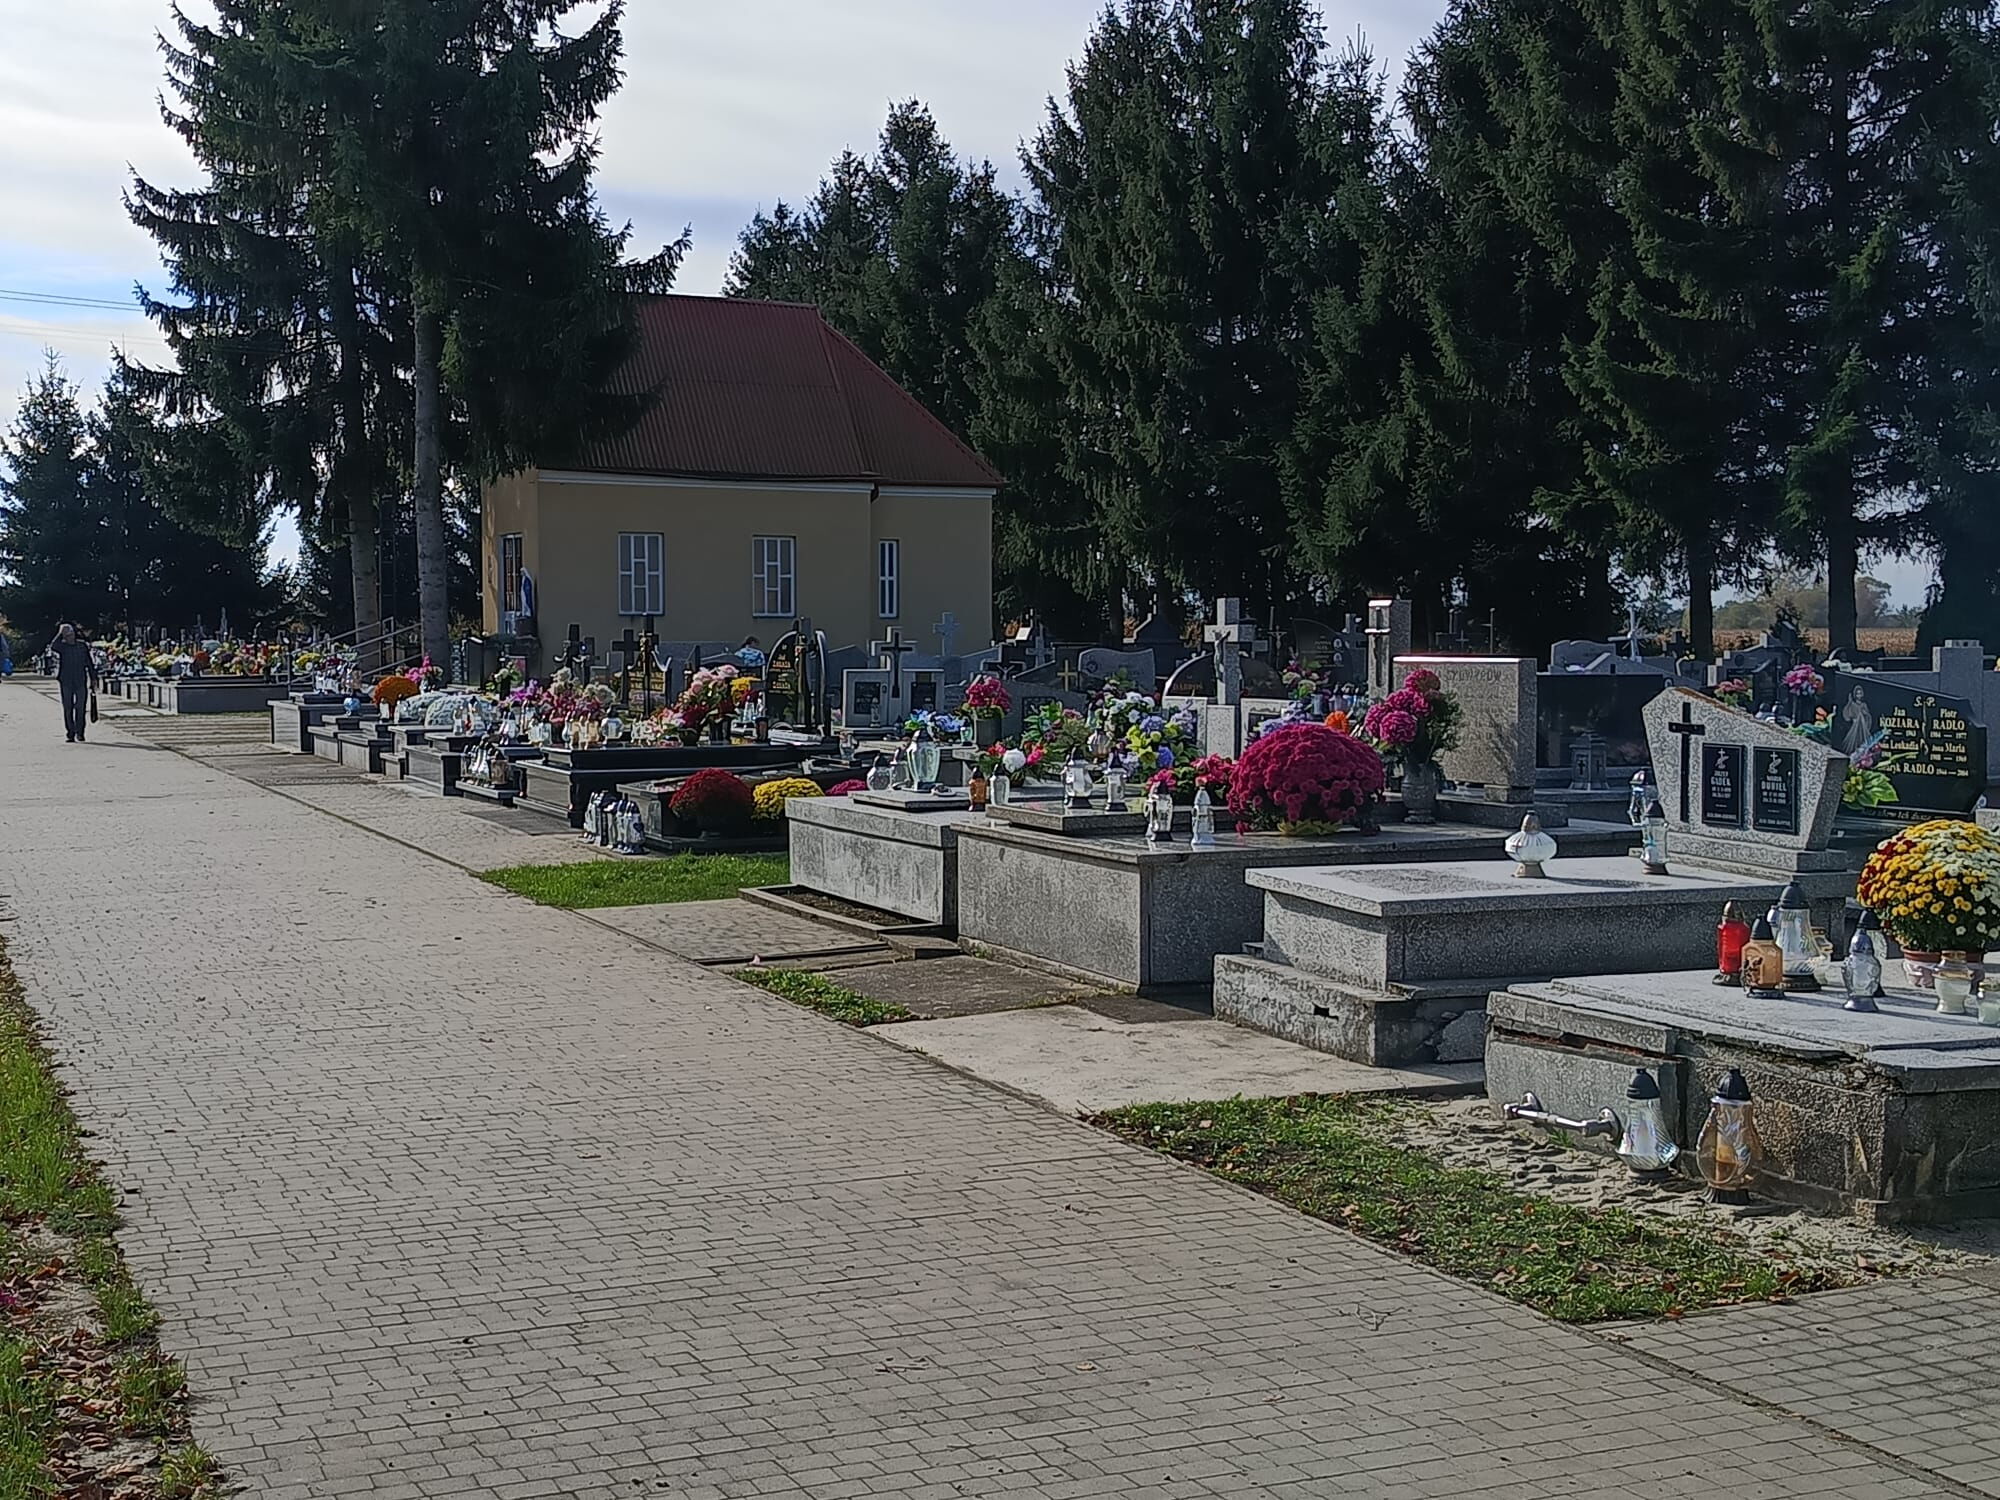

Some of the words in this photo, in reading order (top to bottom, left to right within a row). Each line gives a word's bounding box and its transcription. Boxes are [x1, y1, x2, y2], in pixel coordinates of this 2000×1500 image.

[1893, 706, 1906, 716] Jan
[1940, 708, 1957, 718] Piotr
[1945, 742, 1966, 753] Maria
